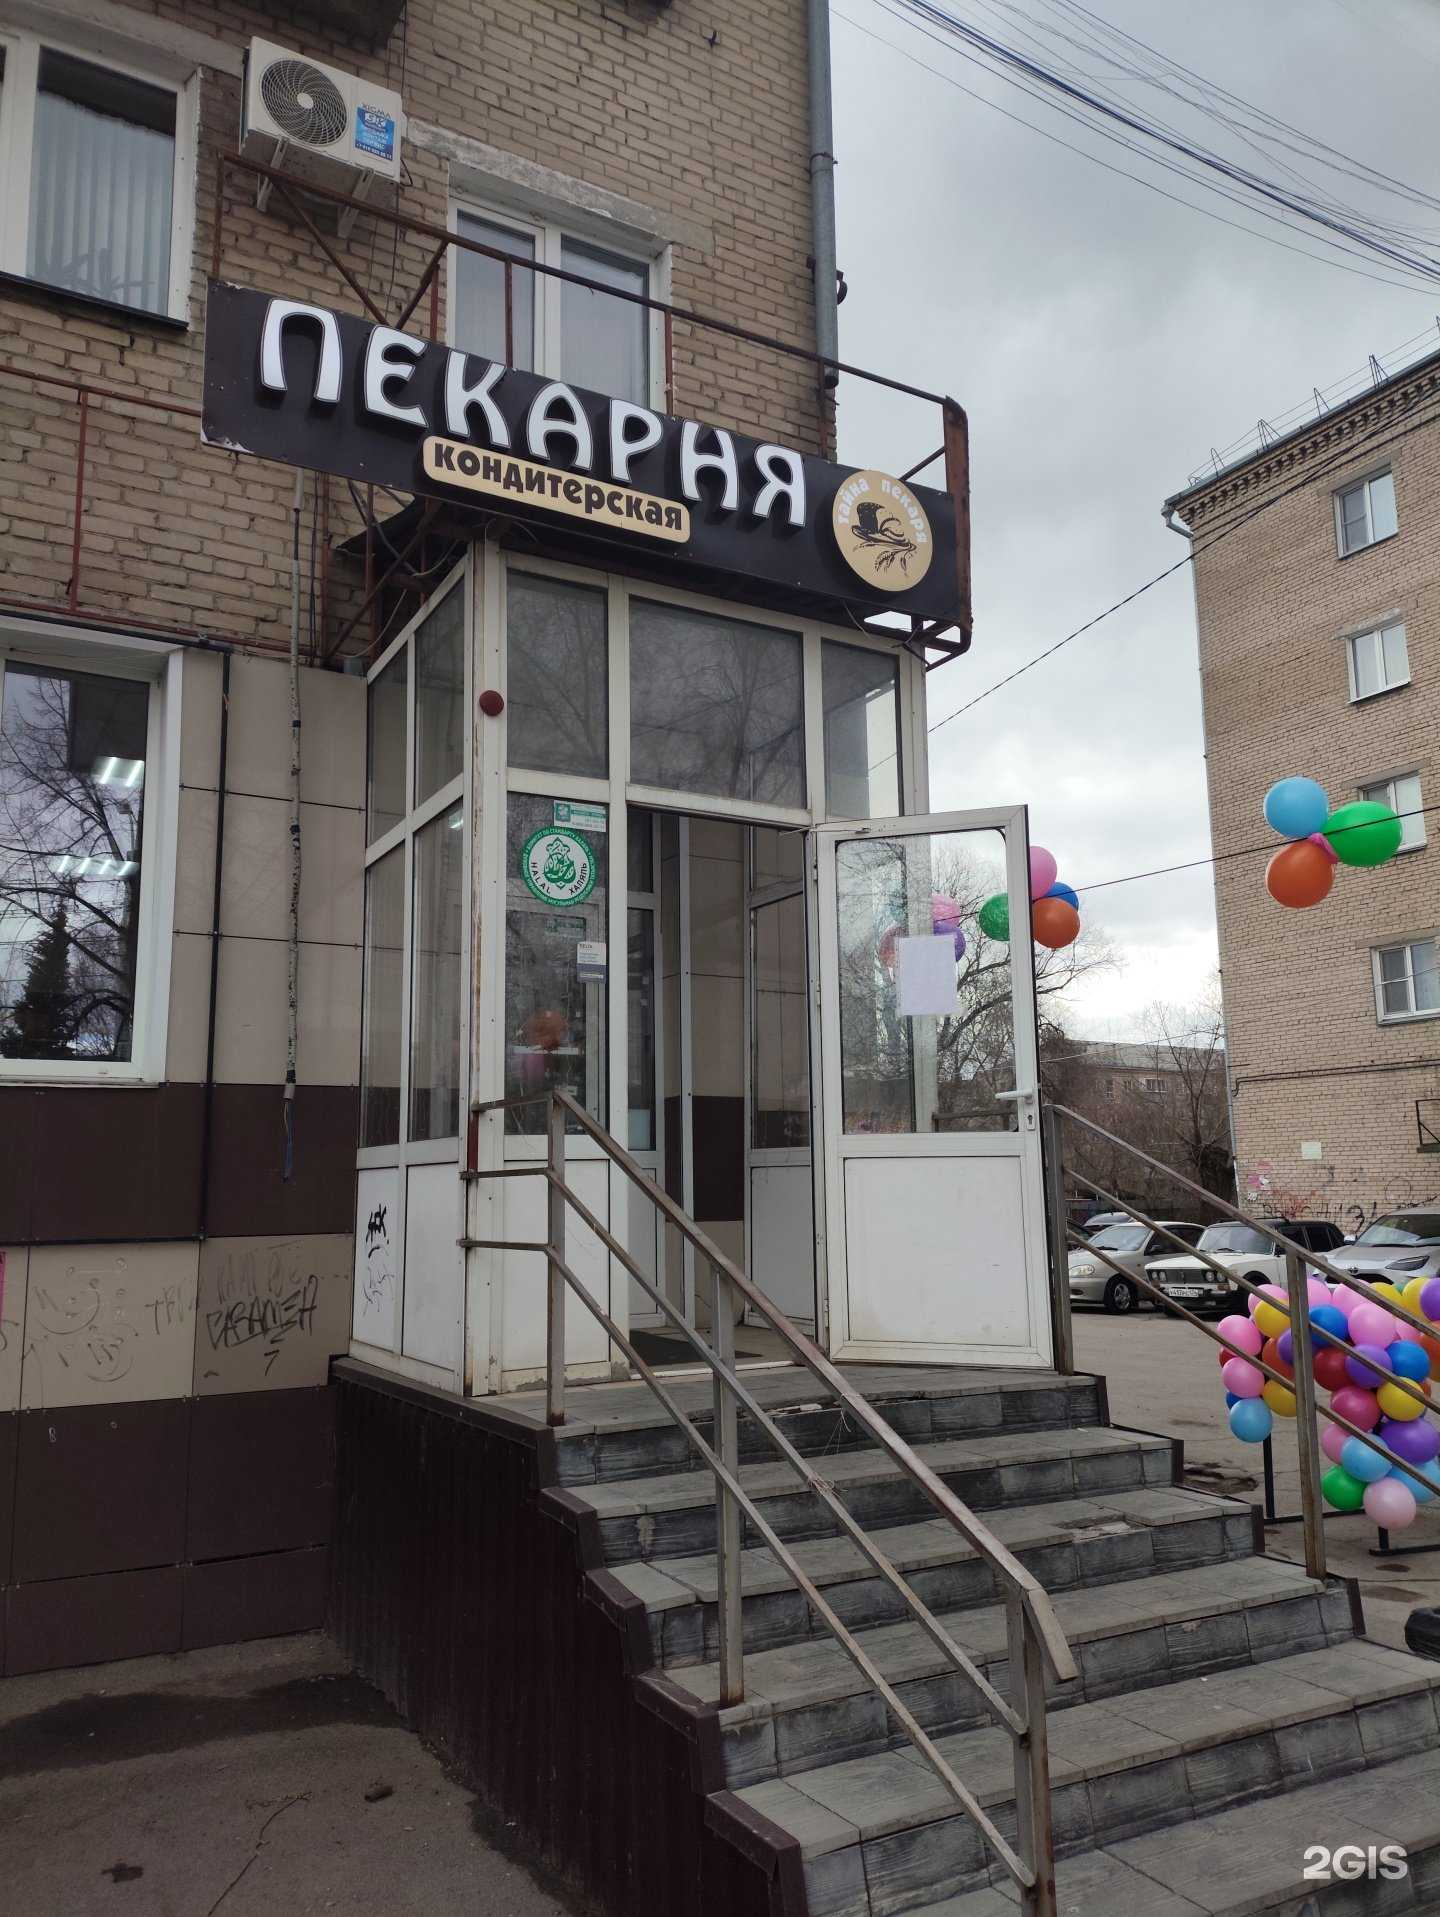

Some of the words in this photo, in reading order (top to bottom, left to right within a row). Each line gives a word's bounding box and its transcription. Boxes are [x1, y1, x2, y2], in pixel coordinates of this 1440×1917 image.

[261, 299, 806, 527] ПЕКАРНЯ
[434, 442, 683, 531] кондитерская
[531, 862, 551, 895] HALAL
[569, 863, 588, 896] ХАЛЯЛЬ
